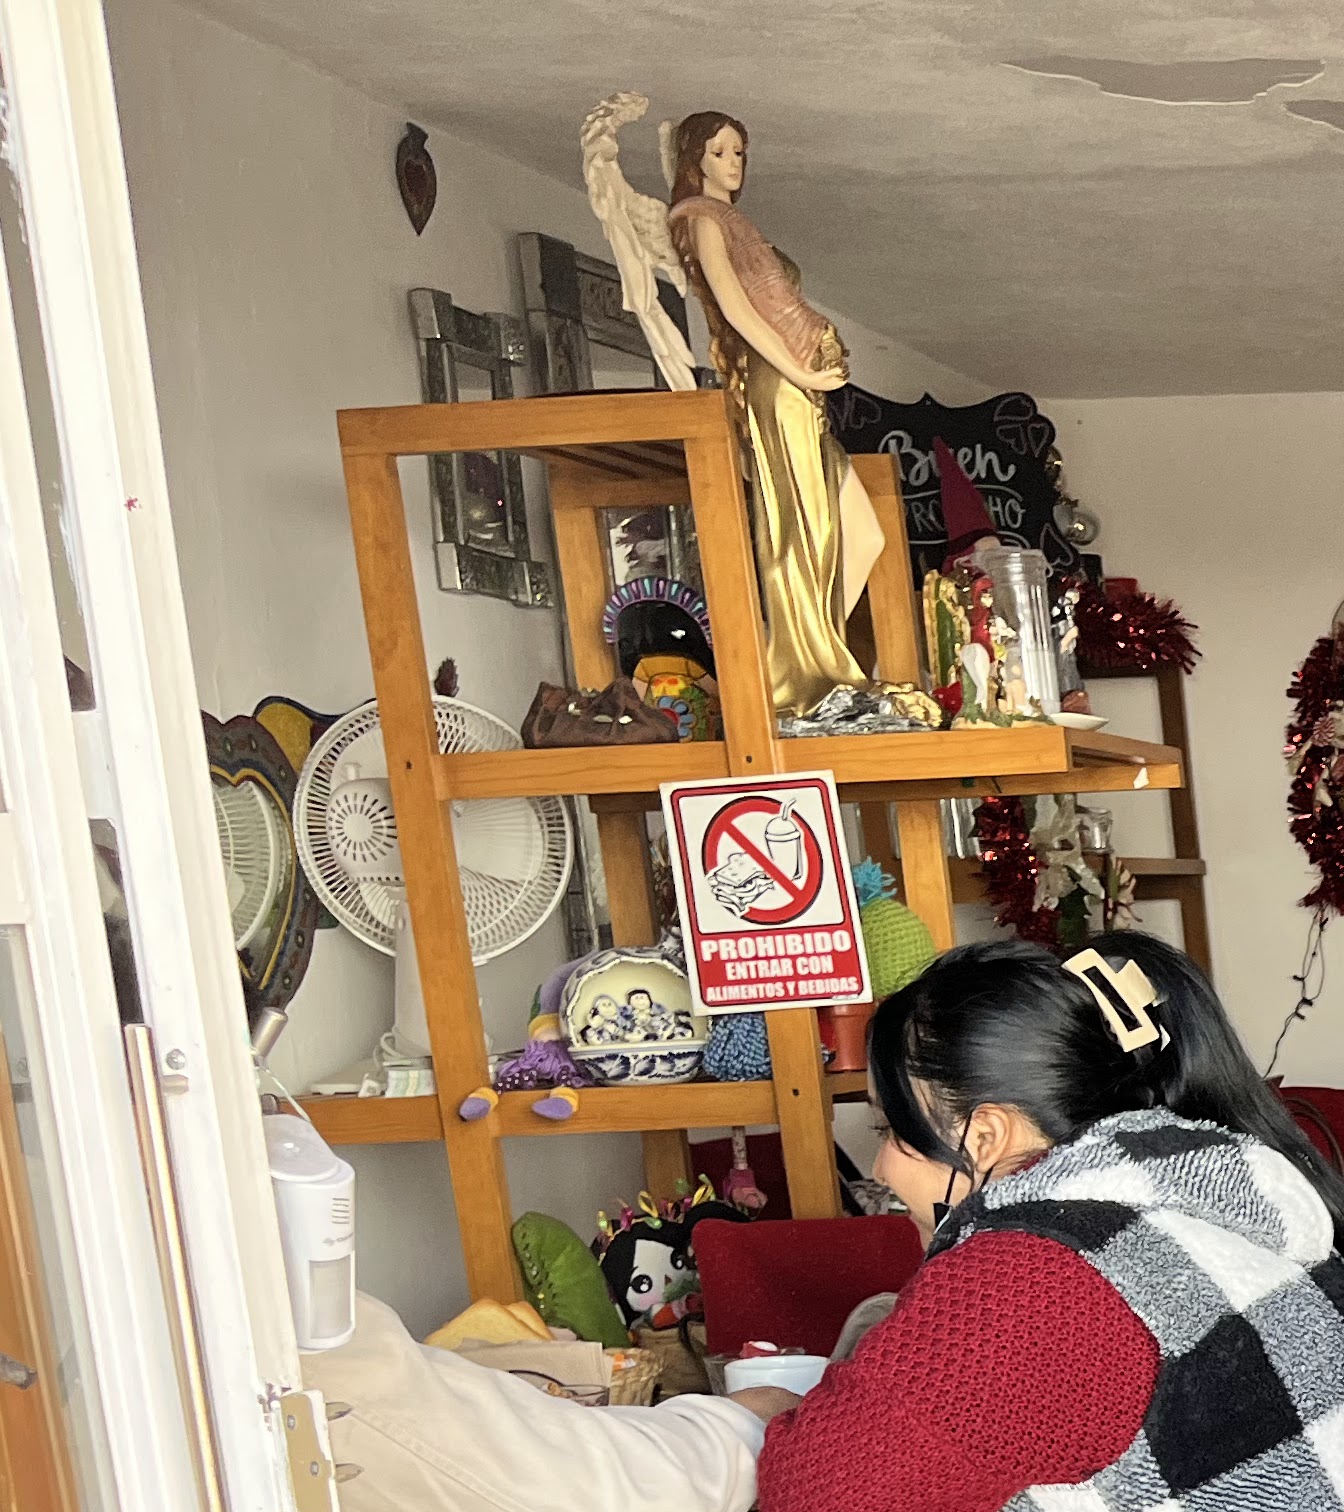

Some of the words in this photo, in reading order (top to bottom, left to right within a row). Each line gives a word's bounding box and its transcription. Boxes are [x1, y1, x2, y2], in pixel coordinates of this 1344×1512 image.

[700, 930, 852, 961] PROHIBIDO
[725, 959, 794, 981] ENTRAR
[797, 955, 834, 976] CON
[706, 982, 785, 1002] ALIMENTOS
[786, 982, 797, 996] Y
[799, 976, 859, 996] BEBIDAS
